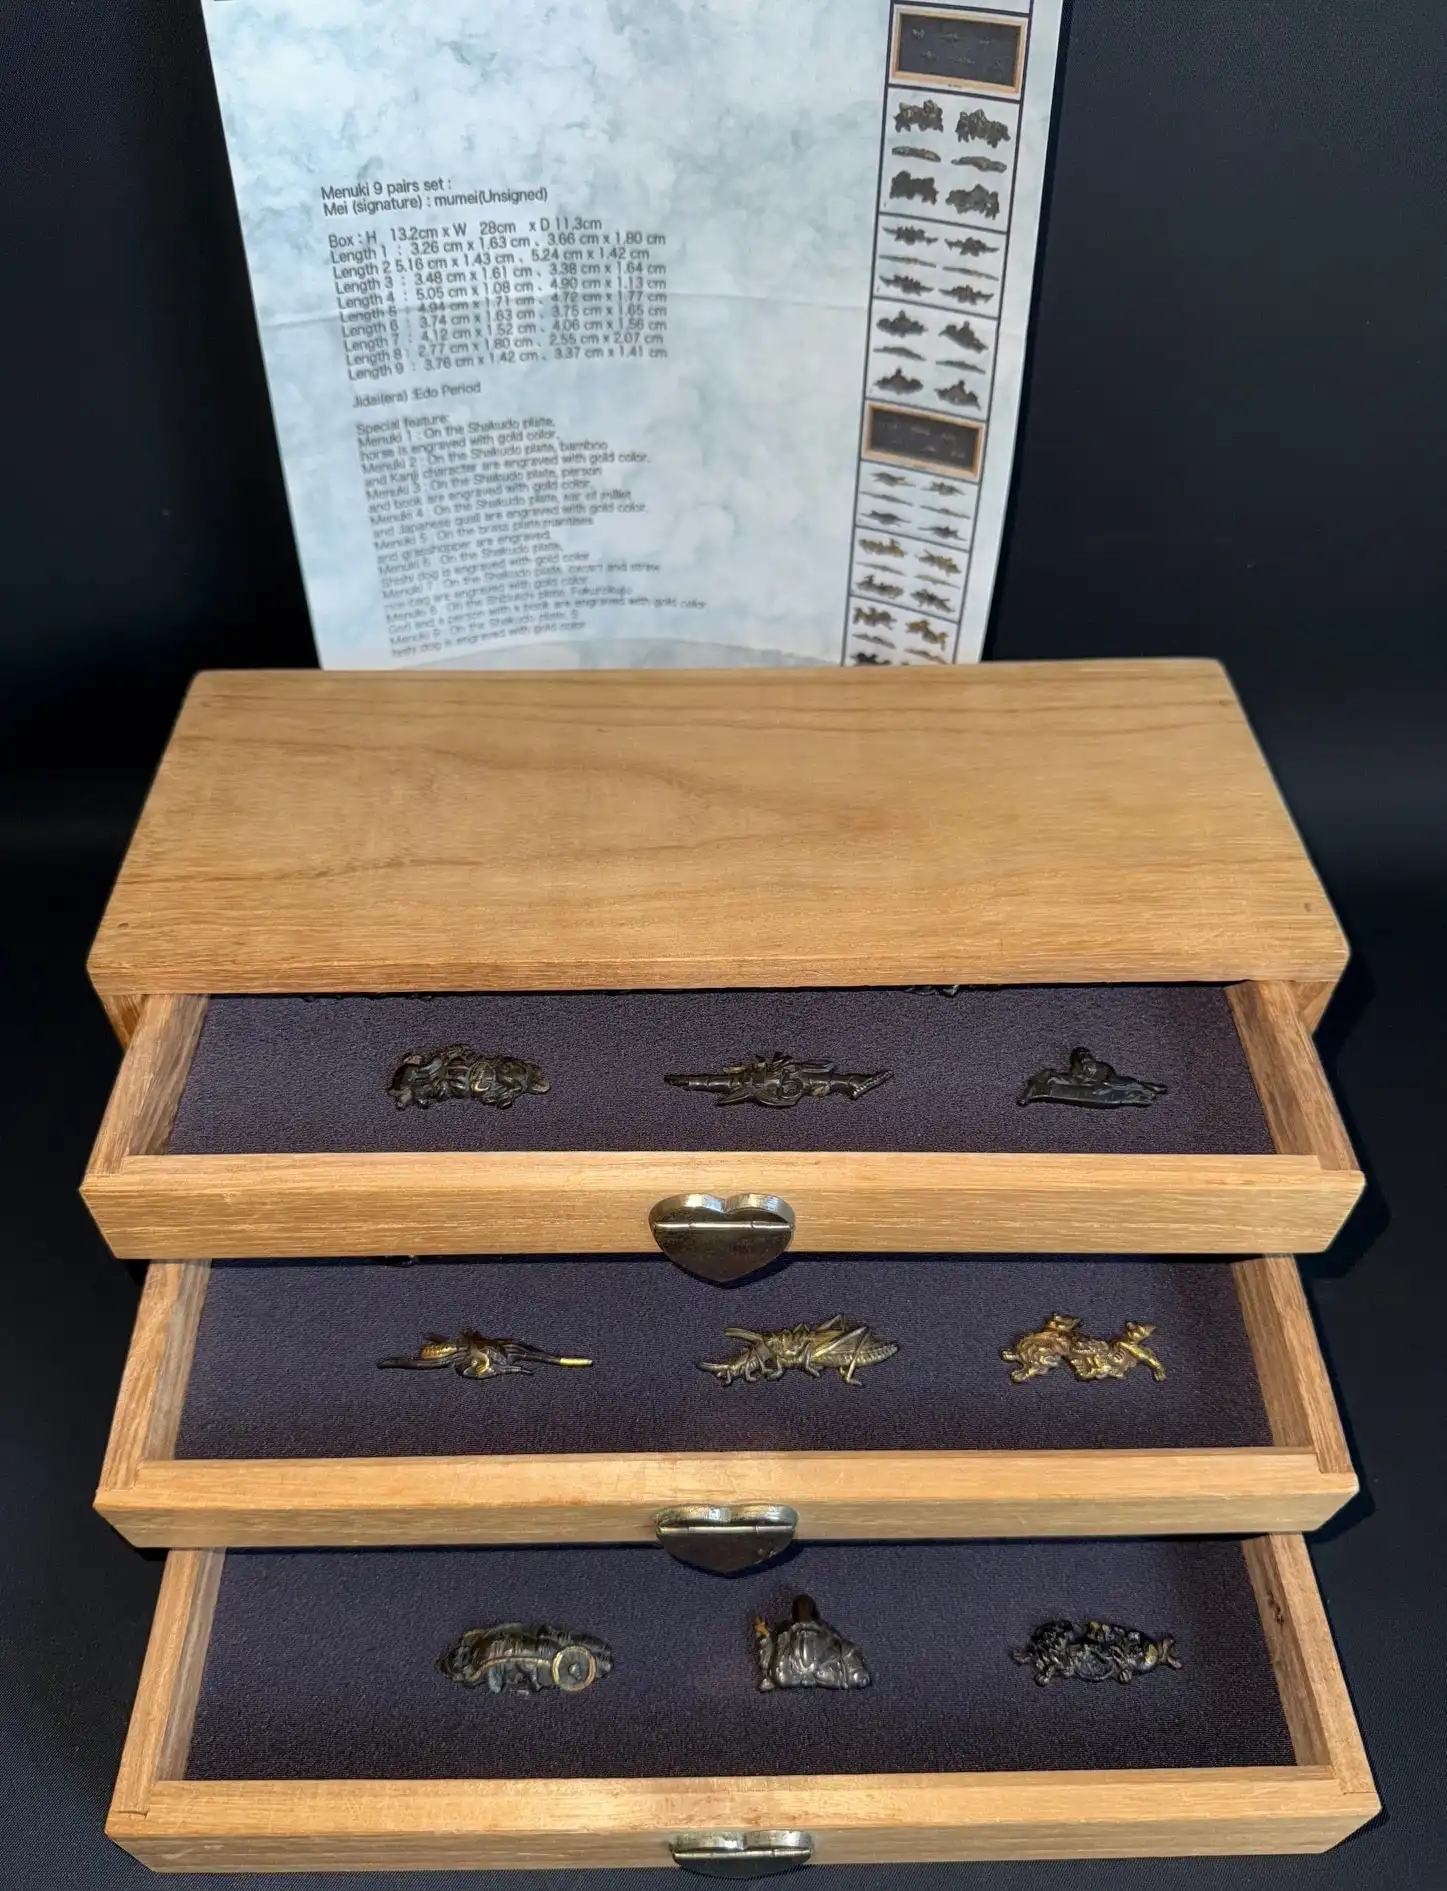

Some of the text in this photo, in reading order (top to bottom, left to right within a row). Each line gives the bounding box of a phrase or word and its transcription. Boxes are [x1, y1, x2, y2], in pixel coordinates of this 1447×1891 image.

[321, 181, 370, 200] Menuki
[373, 182, 383, 195] 9
[387, 179, 419, 196] pairs
[423, 177, 444, 191] set
[323, 201, 348, 216] Mei
[352, 195, 423, 215] (signature)
[434, 187, 548, 206] mumei(Unsigned)
[328, 233, 354, 249] Box
[366, 231, 377, 244] H
[390, 226, 438, 242] 13.2cm
[442, 227, 450, 237] x
[453, 223, 467, 237] W
[480, 221, 516, 236] 28cm
[529, 221, 536, 232] x
[540, 218, 550, 231] D
[555, 216, 602, 231] 11.3cm
[330, 247, 377, 264] Length
[381, 244, 387, 258] 1
[410, 242, 439, 256] 3.26
[443, 241, 463, 253] cm
[467, 240, 474, 250] x
[510, 236, 530, 248] cm
[548, 233, 575, 246] 3.66
[579, 233, 599, 245] cm
[603, 234, 610, 245] x
[615, 231, 642, 245] 1.80
[647, 232, 666, 245] cm
[332, 247, 650, 280] Length 2 5.16 cm x 1.43 cm 5.24 cm x 1.42 cm
[335, 262, 666, 295] Length 3 3.48 cm x 1.61 cm 3.38 cm x 1.64 cm
[336, 276, 666, 310] Length 4 5.05 cm x 1.08 cm 4.90 cm x 1.13 cm
[339, 308, 385, 323] Length
[388, 306, 397, 318] 5
[418, 300, 446, 313] 4.94
[450, 300, 469, 311] cm
[473, 300, 480, 310] x
[485, 295, 510, 308] 1.71
[515, 295, 534, 306] cm
[582, 291, 602, 302] cm
[606, 292, 612, 302] x
[618, 290, 643, 302] 1.77
[647, 291, 667, 302] cm
[341, 322, 387, 338] Length
[390, 319, 399, 332] 6
[419, 315, 447, 329] 3.74
[451, 314, 470, 325] cm
[474, 313, 481, 323] x
[516, 308, 535, 320] cm
[582, 305, 602, 316] cm
[606, 306, 612, 315] x
[618, 303, 644, 316] 1.65
[647, 304, 667, 316] cm
[343, 336, 388, 353] Length
[392, 333, 399, 346] 7
[421, 328, 448, 343] 4.12
[452, 327, 471, 339] cm
[475, 327, 482, 337] x
[517, 322, 536, 334] cm
[552, 319, 580, 331] 4.06
[584, 319, 603, 331] cm
[606, 320, 613, 330] x
[648, 318, 667, 330] cm
[345, 331, 663, 367] Length 8 2.77 cm x 1.80 cm 2.55 cm x 2.07 cm
[348, 364, 392, 381] Length
[395, 362, 404, 375] 9
[455, 356, 474, 368] cm
[478, 355, 484, 365] x
[490, 351, 516, 363] 1.42
[519, 350, 538, 362] cm
[555, 346, 581, 359] 3.37
[584, 347, 603, 358] cm
[608, 348, 614, 358] x
[619, 345, 643, 357] 1.41
[649, 346, 668, 358] cm
